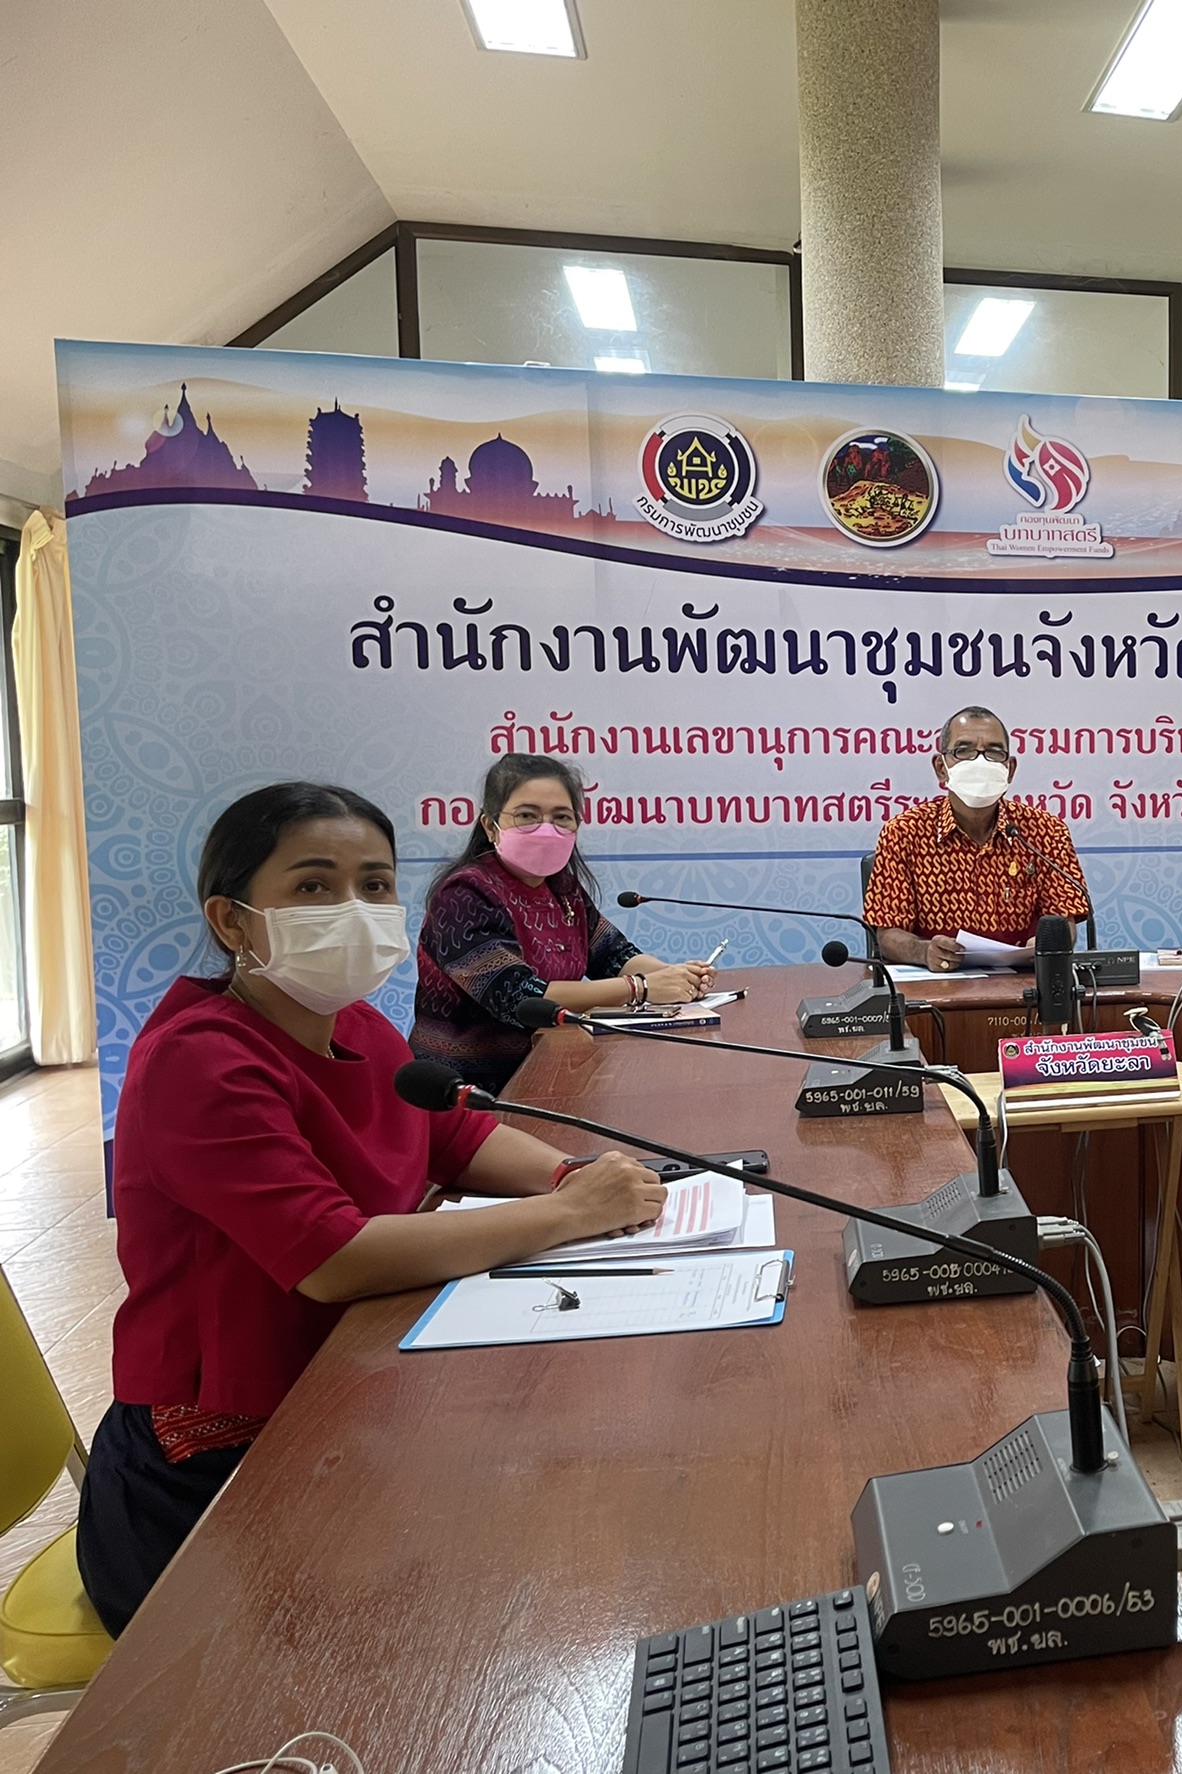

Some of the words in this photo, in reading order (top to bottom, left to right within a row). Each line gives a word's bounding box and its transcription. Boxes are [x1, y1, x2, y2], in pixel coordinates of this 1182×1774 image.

[636, 496, 758, 537] กรมการพัฒนาชุมชน
[1020, 516, 1080, 525] กองทุนพัฒนา
[1004, 527, 1097, 542] บทบาทสตรี
[1009, 544, 1035, 552] Women
[1037, 545, 1087, 554] Empowerment
[1117, 956, 1136, 964] NPE
[1024, 1037, 1157, 1055] สำนักงานพัฒนาชุมชน
[1037, 1055, 1151, 1077] จังหวัดยะลา
[805, 1079, 920, 1103] 5965-001-011/59
[927, 1582, 1156, 1638] 5965-001-0006/53
